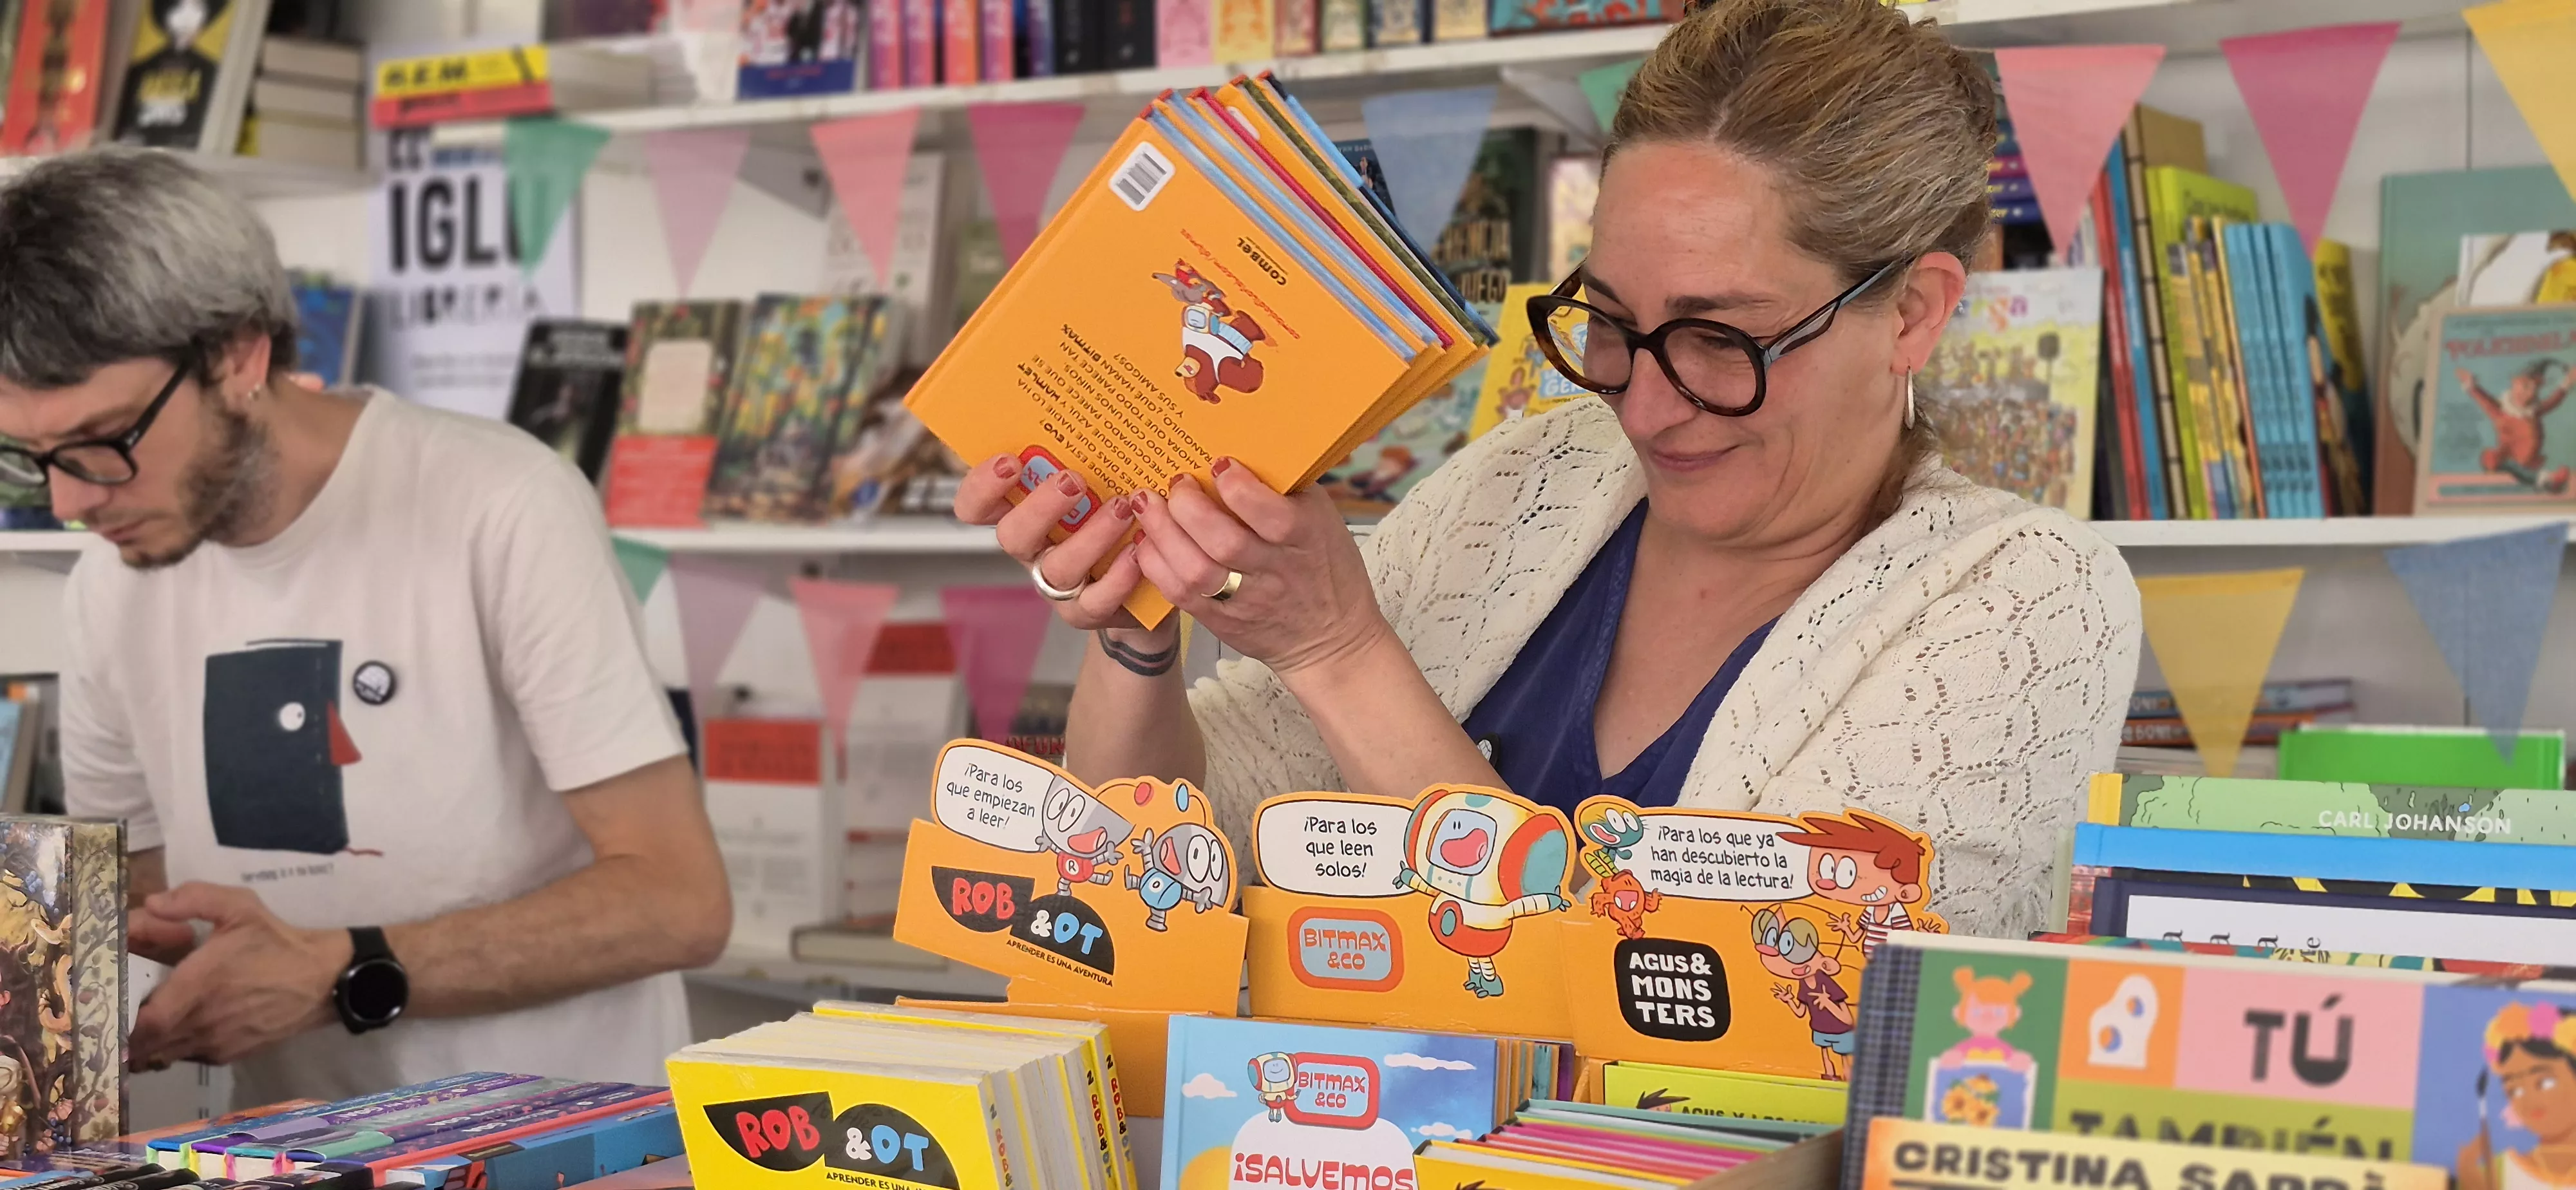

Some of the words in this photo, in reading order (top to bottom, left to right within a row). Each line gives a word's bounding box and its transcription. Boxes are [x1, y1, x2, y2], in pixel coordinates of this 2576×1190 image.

[1032, 356, 1043, 367] SE
[1059, 341, 1079, 361] TAN
[1045, 366, 1065, 386] QUE
[1079, 359, 1115, 393] PARECE
[1100, 359, 1135, 392] HARÁN
[1113, 353, 1159, 392] AMIGOS?
[1018, 378, 1032, 393] HA
[1032, 392, 1046, 406] LO
[1066, 386, 1102, 419] PARECE
[1094, 392, 1122, 419] UNOS
[1115, 393, 1144, 420] TODO
[1134, 391, 1163, 413] ¿QUÉ
[1157, 392, 1177, 410] SUS
[1045, 407, 1075, 433] NADIE
[1069, 405, 1092, 428] AZUL
[1122, 418, 1145, 440] CON
[1144, 419, 1166, 439] QUE
[1065, 440, 1088, 463] ESTÁ
[1075, 431, 1096, 452] QUE
[1092, 428, 1132, 465] BOSQUE
[1146, 439, 1165, 457] IDO
[1167, 437, 1201, 469] AHORA
[1096, 451, 1119, 473] DÍAS
[1133, 463, 1144, 476] EL
[1166, 455, 1180, 471] HA
[1087, 462, 1129, 498] ¿DÓNDE
[1119, 471, 1138, 489] RES
[1143, 475, 1158, 489] EN
[964, 762, 998, 787] ¡Para
[1002, 773, 1023, 794] los
[946, 781, 970, 801] que
[974, 791, 1036, 818] empiezan
[966, 808, 976, 821] a
[978, 808, 1010, 829] leer!
[1303, 816, 1346, 834] ¡Para
[1352, 818, 1378, 835] los
[2318, 809, 2374, 829] CARL
[2383, 813, 2512, 835] JOHANSON
[1305, 841, 1336, 857] que
[1340, 839, 1374, 857] leen
[1658, 826, 1696, 844] ¡Para
[1699, 827, 1721, 845] los
[1726, 832, 1752, 848] que
[1756, 835, 1776, 849] ya
[1068, 858, 1077, 873] R
[1651, 846, 1676, 863] han
[1681, 848, 1770, 869] descubierto
[1774, 853, 1788, 869] la
[1315, 861, 1367, 878] solos!
[1651, 868, 1692, 887] magia
[1697, 869, 1714, 885] de
[1718, 870, 1730, 886] la
[1734, 871, 1794, 890] lectura!
[952, 877, 1015, 920] ROB
[1303, 928, 1386, 952] BITMAX
[1005, 938, 1045, 960] APRENDER
[1046, 954, 1056, 965] ES
[1056, 958, 1073, 972] UNA
[1073, 965, 1113, 987] AVENTURA
[1327, 952, 1366, 970] &CO
[1629, 952, 1712, 976] AGUS&
[1631, 976, 1712, 1002] MONS
[1634, 1002, 1716, 1028] TERS
[2242, 993, 2354, 1087] TÚ
[1297, 1070, 1367, 1093] BITMAX
[1314, 1092, 1347, 1109] &CO
[735, 1105, 820, 1158] ROB
[1233, 1152, 1414, 1190] ¡SALVEMOS
[1892, 1140, 2154, 1190] CRISTINA
[826, 1171, 876, 1187] APRENDER
[878, 1179, 890, 1190] ES
